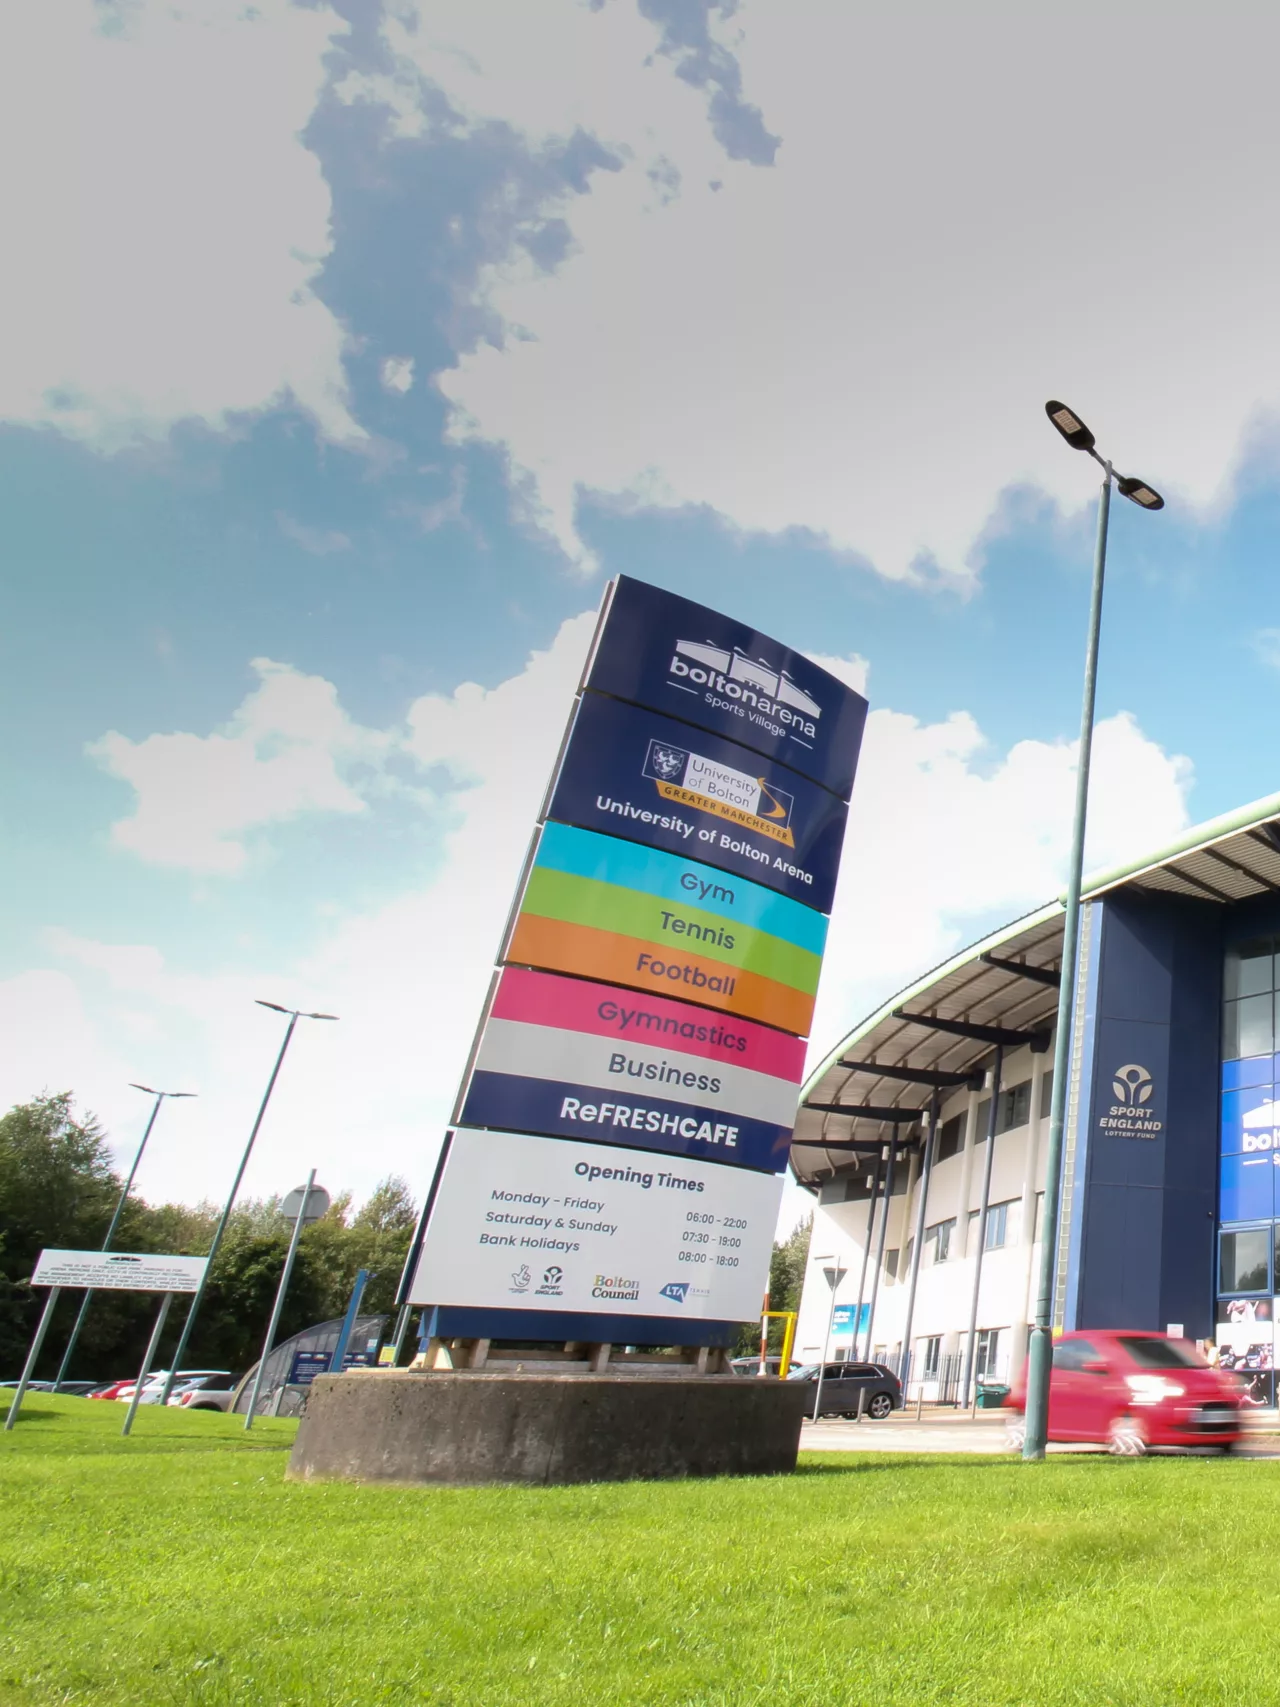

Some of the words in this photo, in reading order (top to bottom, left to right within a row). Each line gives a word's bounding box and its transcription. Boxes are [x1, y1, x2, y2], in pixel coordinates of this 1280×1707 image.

[669, 656, 816, 739] boltonarena
[704, 692, 745, 718] Sports
[748, 711, 786, 738] Village
[688, 776, 704, 789] of
[707, 782, 750, 808] Bolton
[692, 759, 757, 797] University
[664, 786, 716, 811] GREATER
[721, 806, 788, 841] MANCHESTER
[596, 795, 694, 838] University
[699, 826, 716, 844] of
[719, 835, 770, 865] Bolton
[772, 857, 813, 885] Arena
[680, 872, 736, 905] Gym
[659, 910, 736, 950] Tennis
[636, 952, 737, 997] Football
[598, 1001, 748, 1053] Gymnastics
[608, 1052, 722, 1094] Business
[560, 1097, 739, 1148] ReFRESHCAFE
[1099, 1117, 1162, 1131] ENGLAND
[1109, 1105, 1153, 1118] SPORT
[1105, 1130, 1134, 1138] LOTTERY
[1136, 1131, 1155, 1139] FUND
[575, 1161, 652, 1190] Opening
[657, 1172, 705, 1193] Times
[491, 1189, 550, 1208] Monday
[564, 1196, 605, 1213] Friday
[485, 1211, 552, 1230] Saturday
[555, 1217, 565, 1229] &
[568, 1218, 618, 1236] Sunday
[686, 1211, 714, 1225] 06:00
[723, 1216, 748, 1230] 22:00
[479, 1233, 516, 1247] Bank
[520, 1236, 580, 1253] Holidays
[682, 1231, 709, 1245] 07:30
[718, 1235, 742, 1248] 19:00
[678, 1251, 707, 1264] 08:00
[716, 1255, 740, 1268] 18:00
[592, 1287, 640, 1300] Council
[593, 1274, 640, 1289] Bolton
[666, 1285, 685, 1298] LTA
